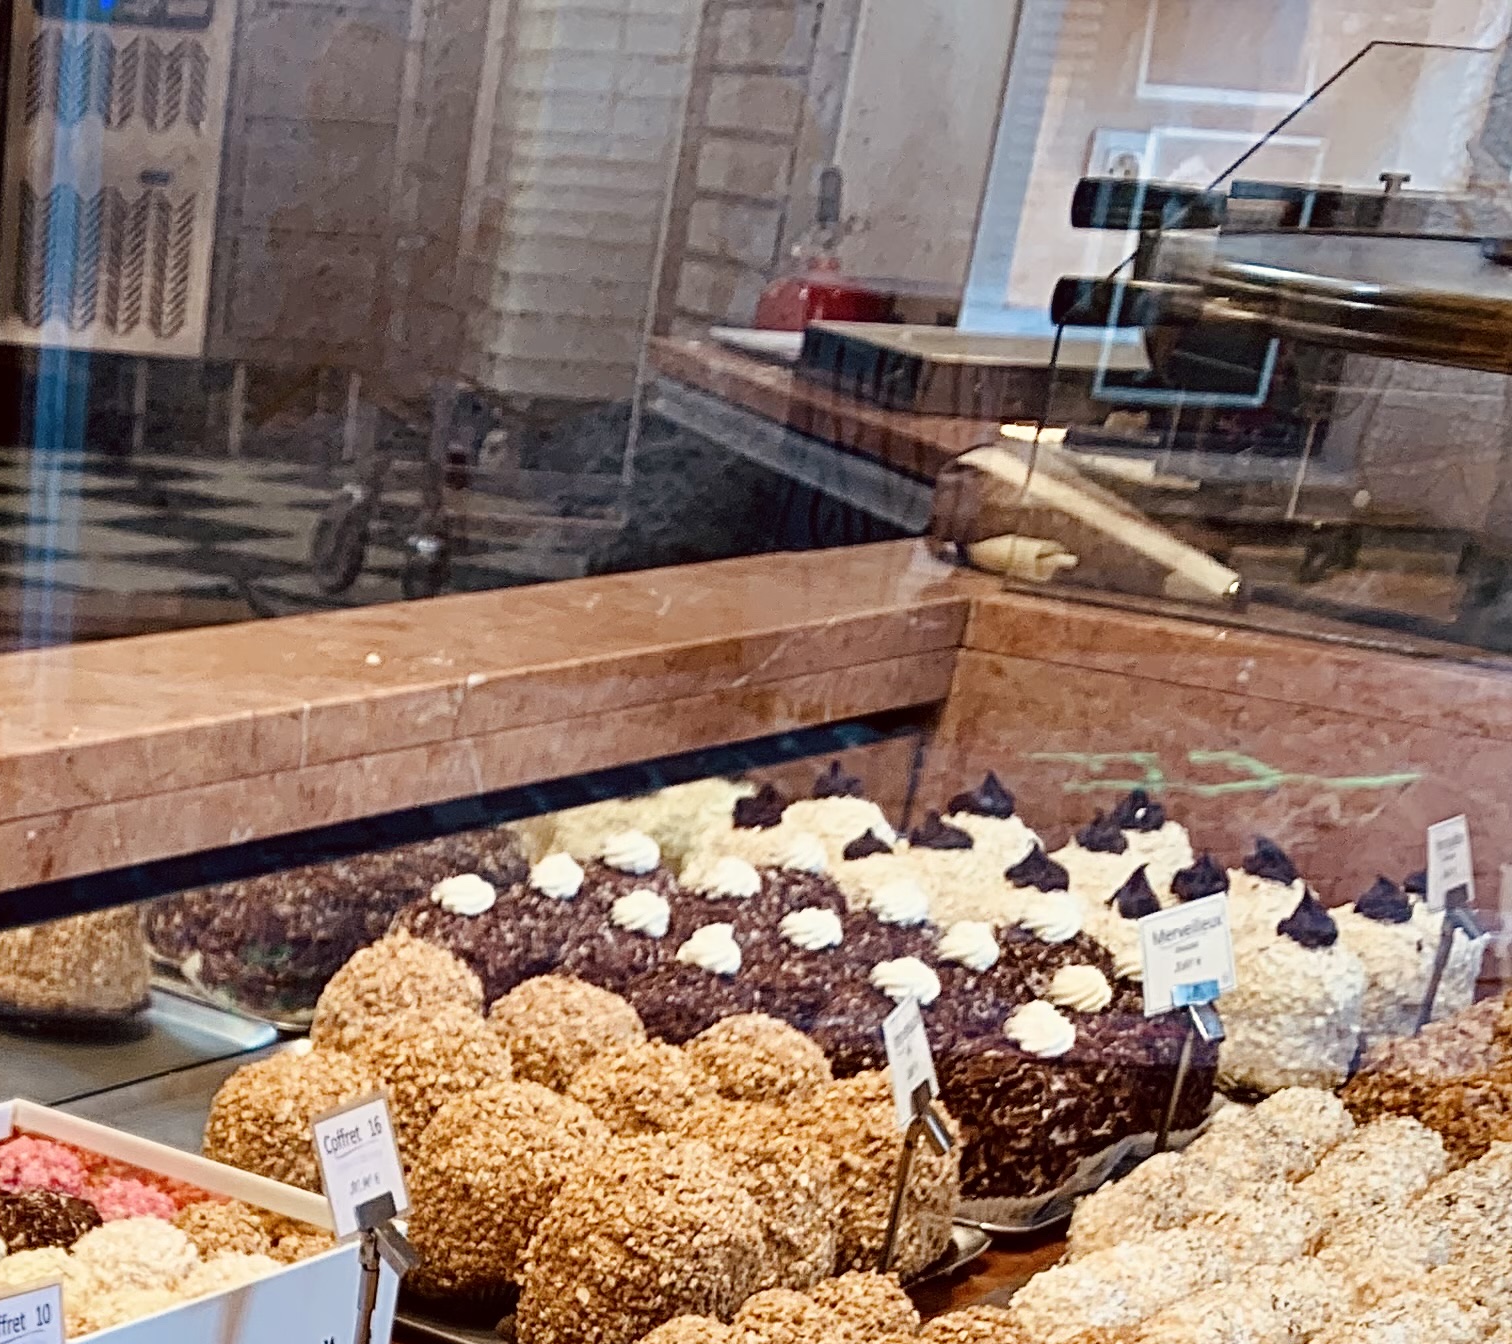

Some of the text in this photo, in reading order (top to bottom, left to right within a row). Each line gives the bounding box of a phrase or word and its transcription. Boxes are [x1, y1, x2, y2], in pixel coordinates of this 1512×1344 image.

[323, 1115, 382, 1154] Coffret 16
[36, 1303, 51, 1326] 10
